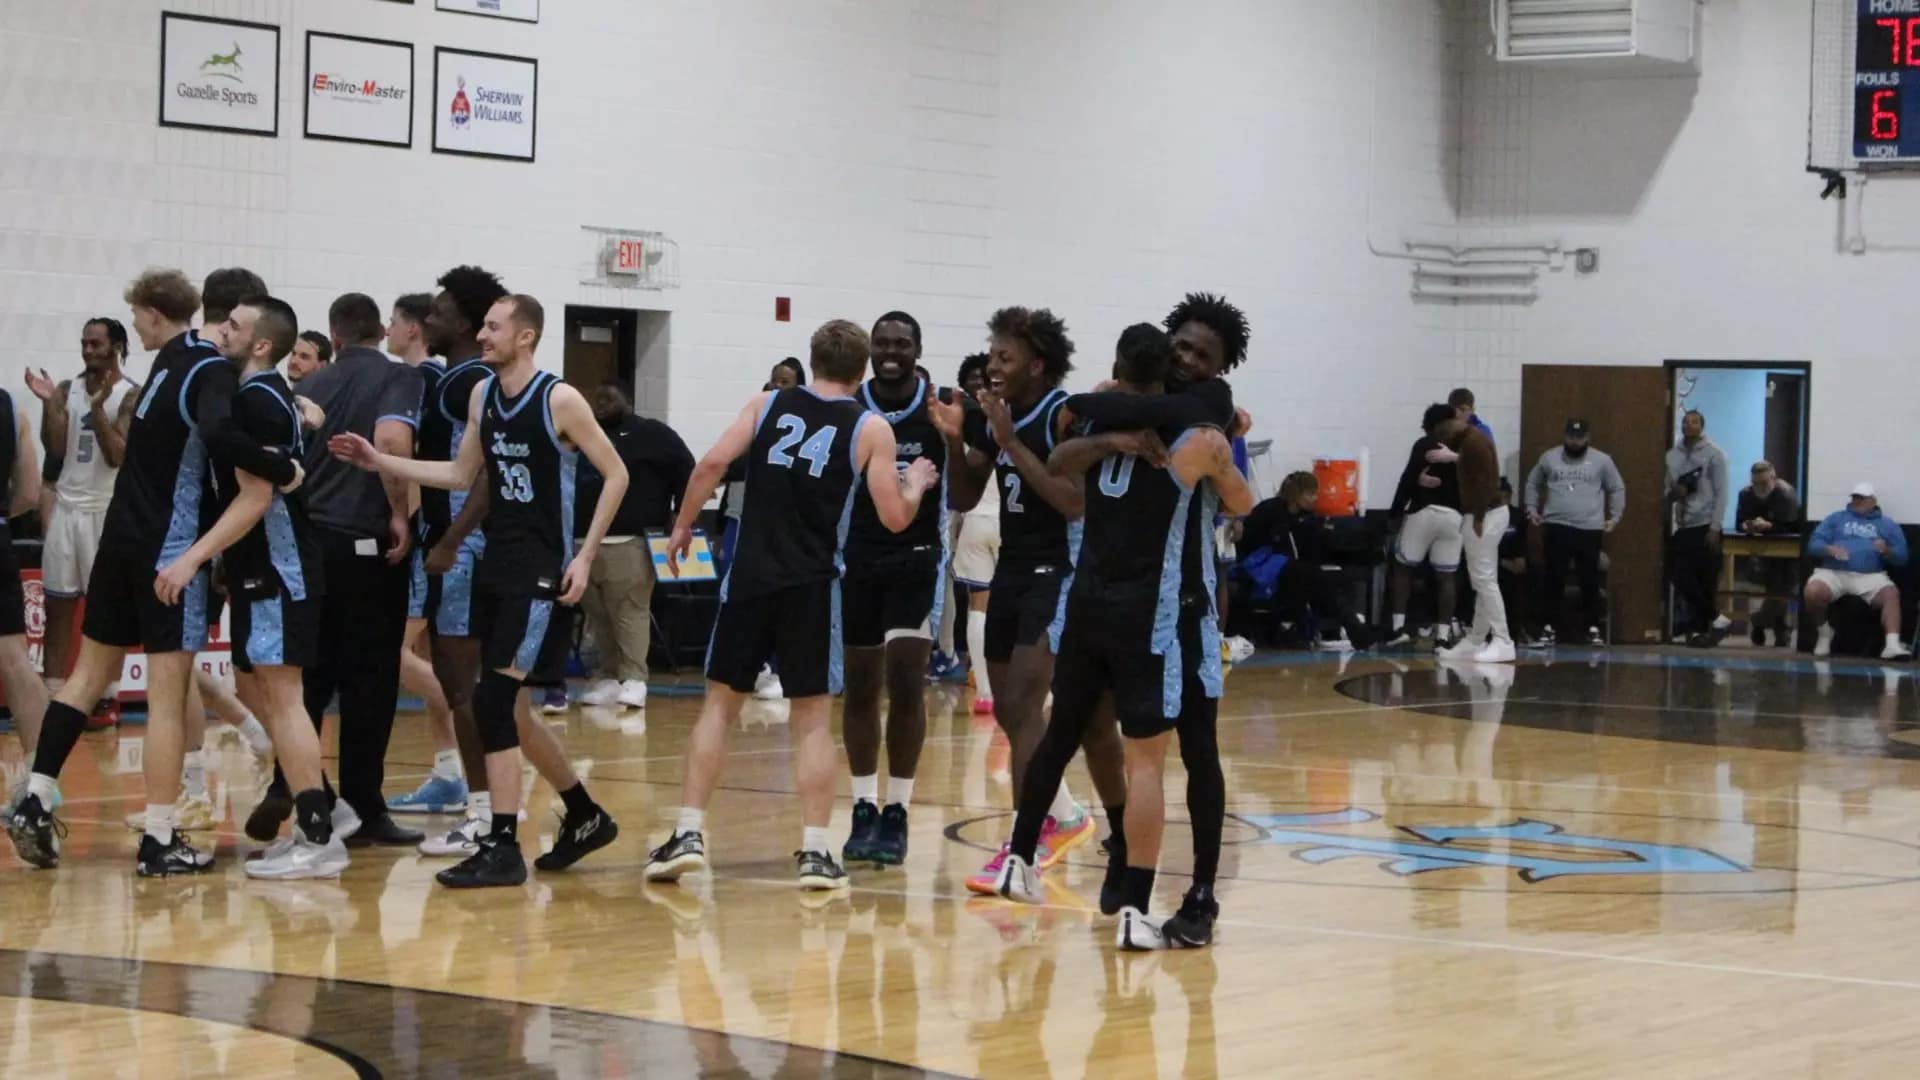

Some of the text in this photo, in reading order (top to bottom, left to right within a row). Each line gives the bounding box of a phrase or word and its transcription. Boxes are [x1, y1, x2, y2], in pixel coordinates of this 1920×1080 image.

[1869, 0, 1919, 14] HOME
[312, 72, 406, 100] Enviro-Master
[1855, 72, 1900, 86] FOULS
[177, 82, 258, 107] Gazelle Sports
[1870, 90, 1898, 139] 6
[1866, 145, 1898, 158] WON
[618, 240, 642, 269] EXIT
[767, 412, 838, 479] 24
[496, 460, 535, 503] 33
[1004, 473, 1025, 513] 2
